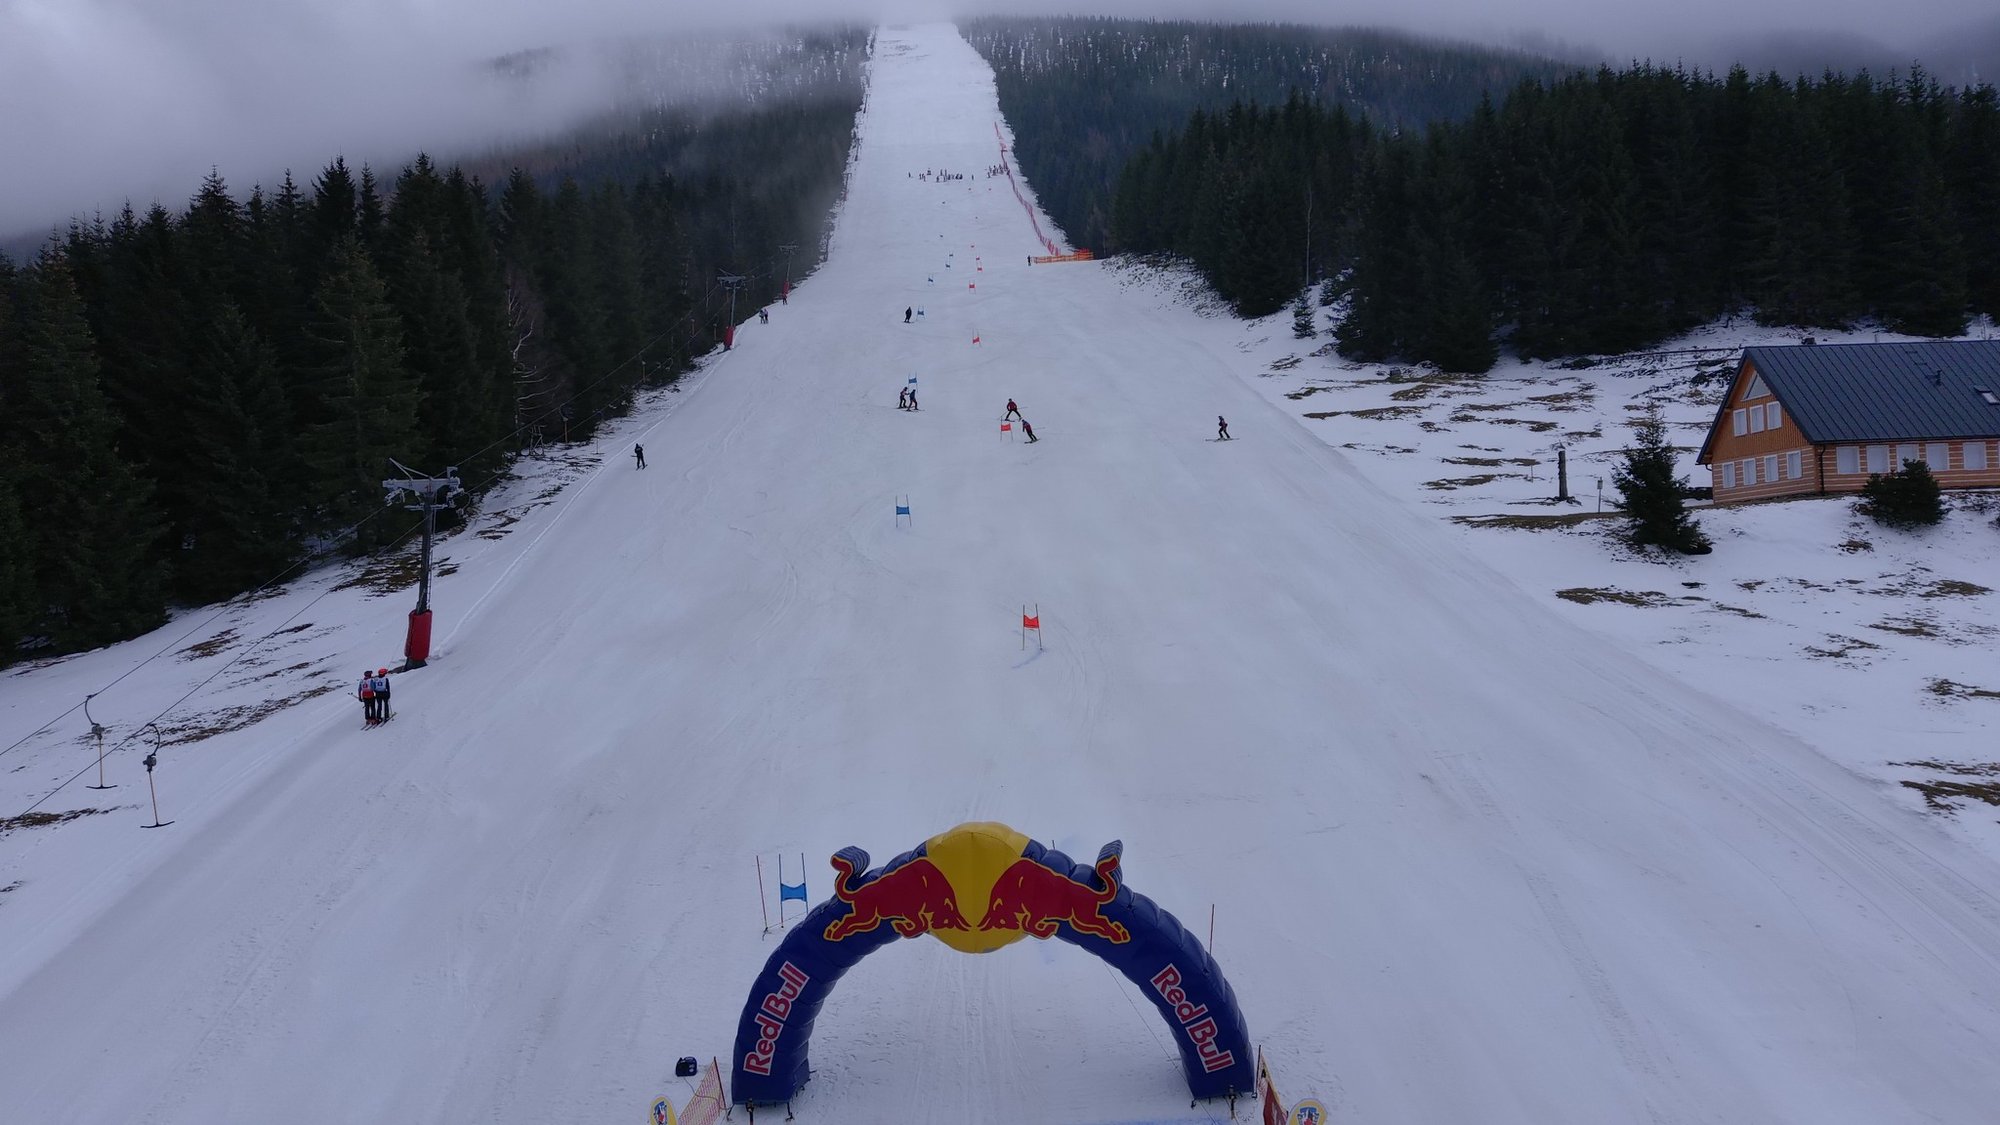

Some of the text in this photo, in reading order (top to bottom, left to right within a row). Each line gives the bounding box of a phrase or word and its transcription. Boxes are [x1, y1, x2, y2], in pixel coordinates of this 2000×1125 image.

[744, 961, 810, 1075] Red Bull
[1151, 964, 1235, 1073] Red Bull
